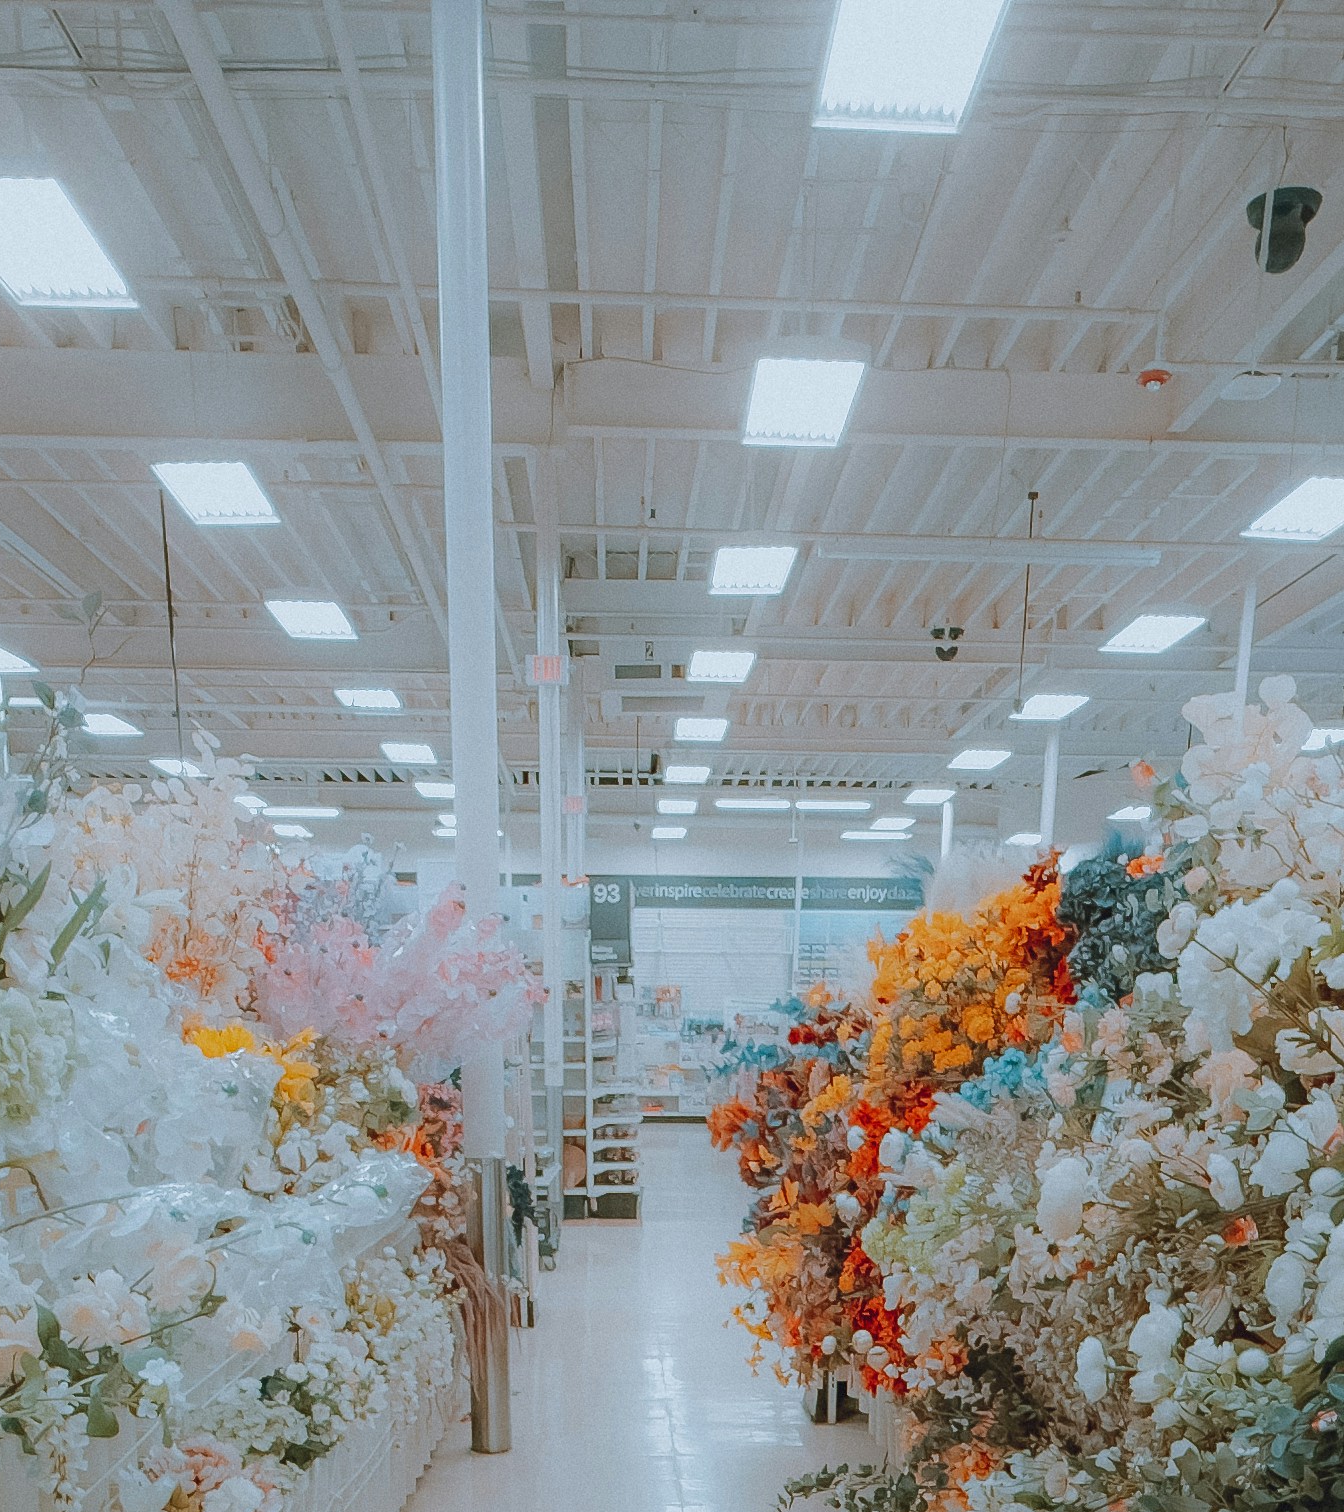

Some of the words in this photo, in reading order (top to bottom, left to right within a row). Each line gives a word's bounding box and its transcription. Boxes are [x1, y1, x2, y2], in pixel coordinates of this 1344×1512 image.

[593, 883, 621, 903] 93
[656, 883, 702, 900] inspire
[702, 883, 766, 899] celebrate
[766, 886, 809, 899] creae
[848, 884, 887, 903] enjoy
